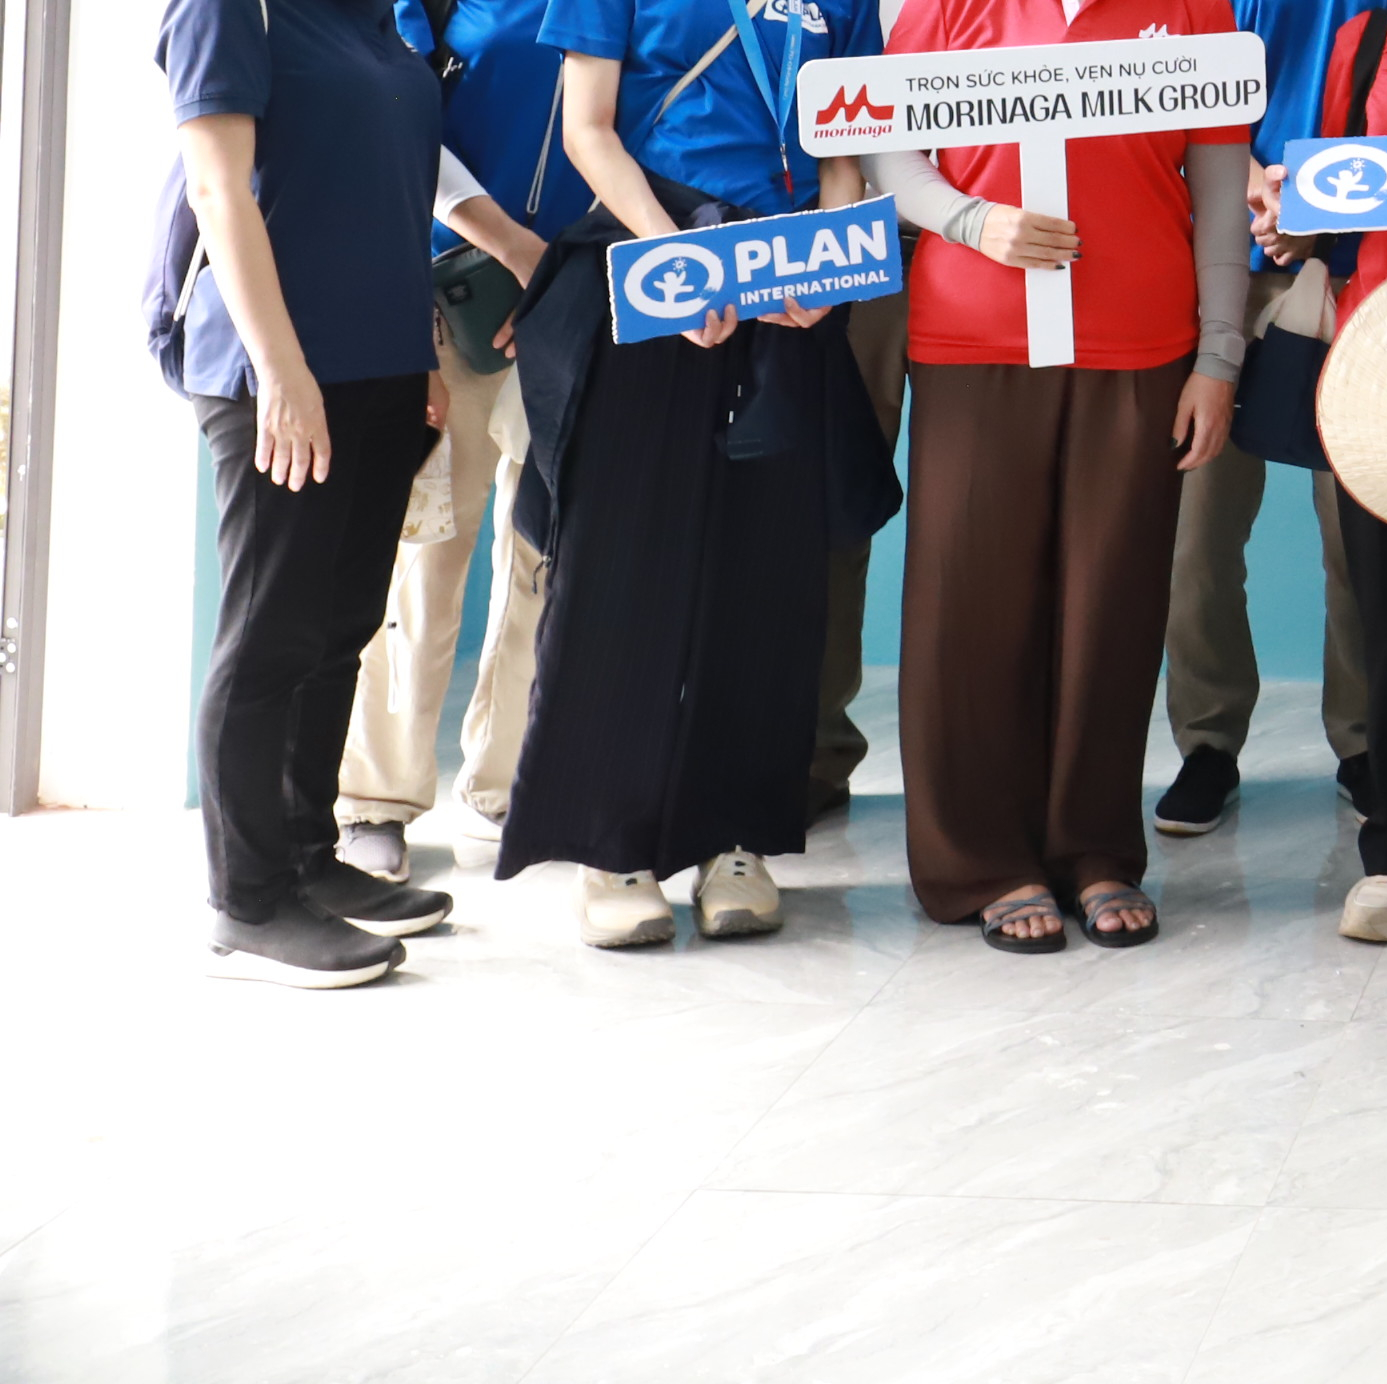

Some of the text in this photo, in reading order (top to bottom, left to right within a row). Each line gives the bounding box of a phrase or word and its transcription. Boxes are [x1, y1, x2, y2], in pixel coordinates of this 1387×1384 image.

[906, 57, 1197, 94] TRỌN SỨC KHỎE, VẸN NỤ CƯỜI
[906, 79, 1261, 131] MORINAGA MILK GROUP
[813, 123, 894, 139] morinaga
[735, 220, 888, 283] PLAN
[739, 269, 890, 306] INTERNATIONAL
